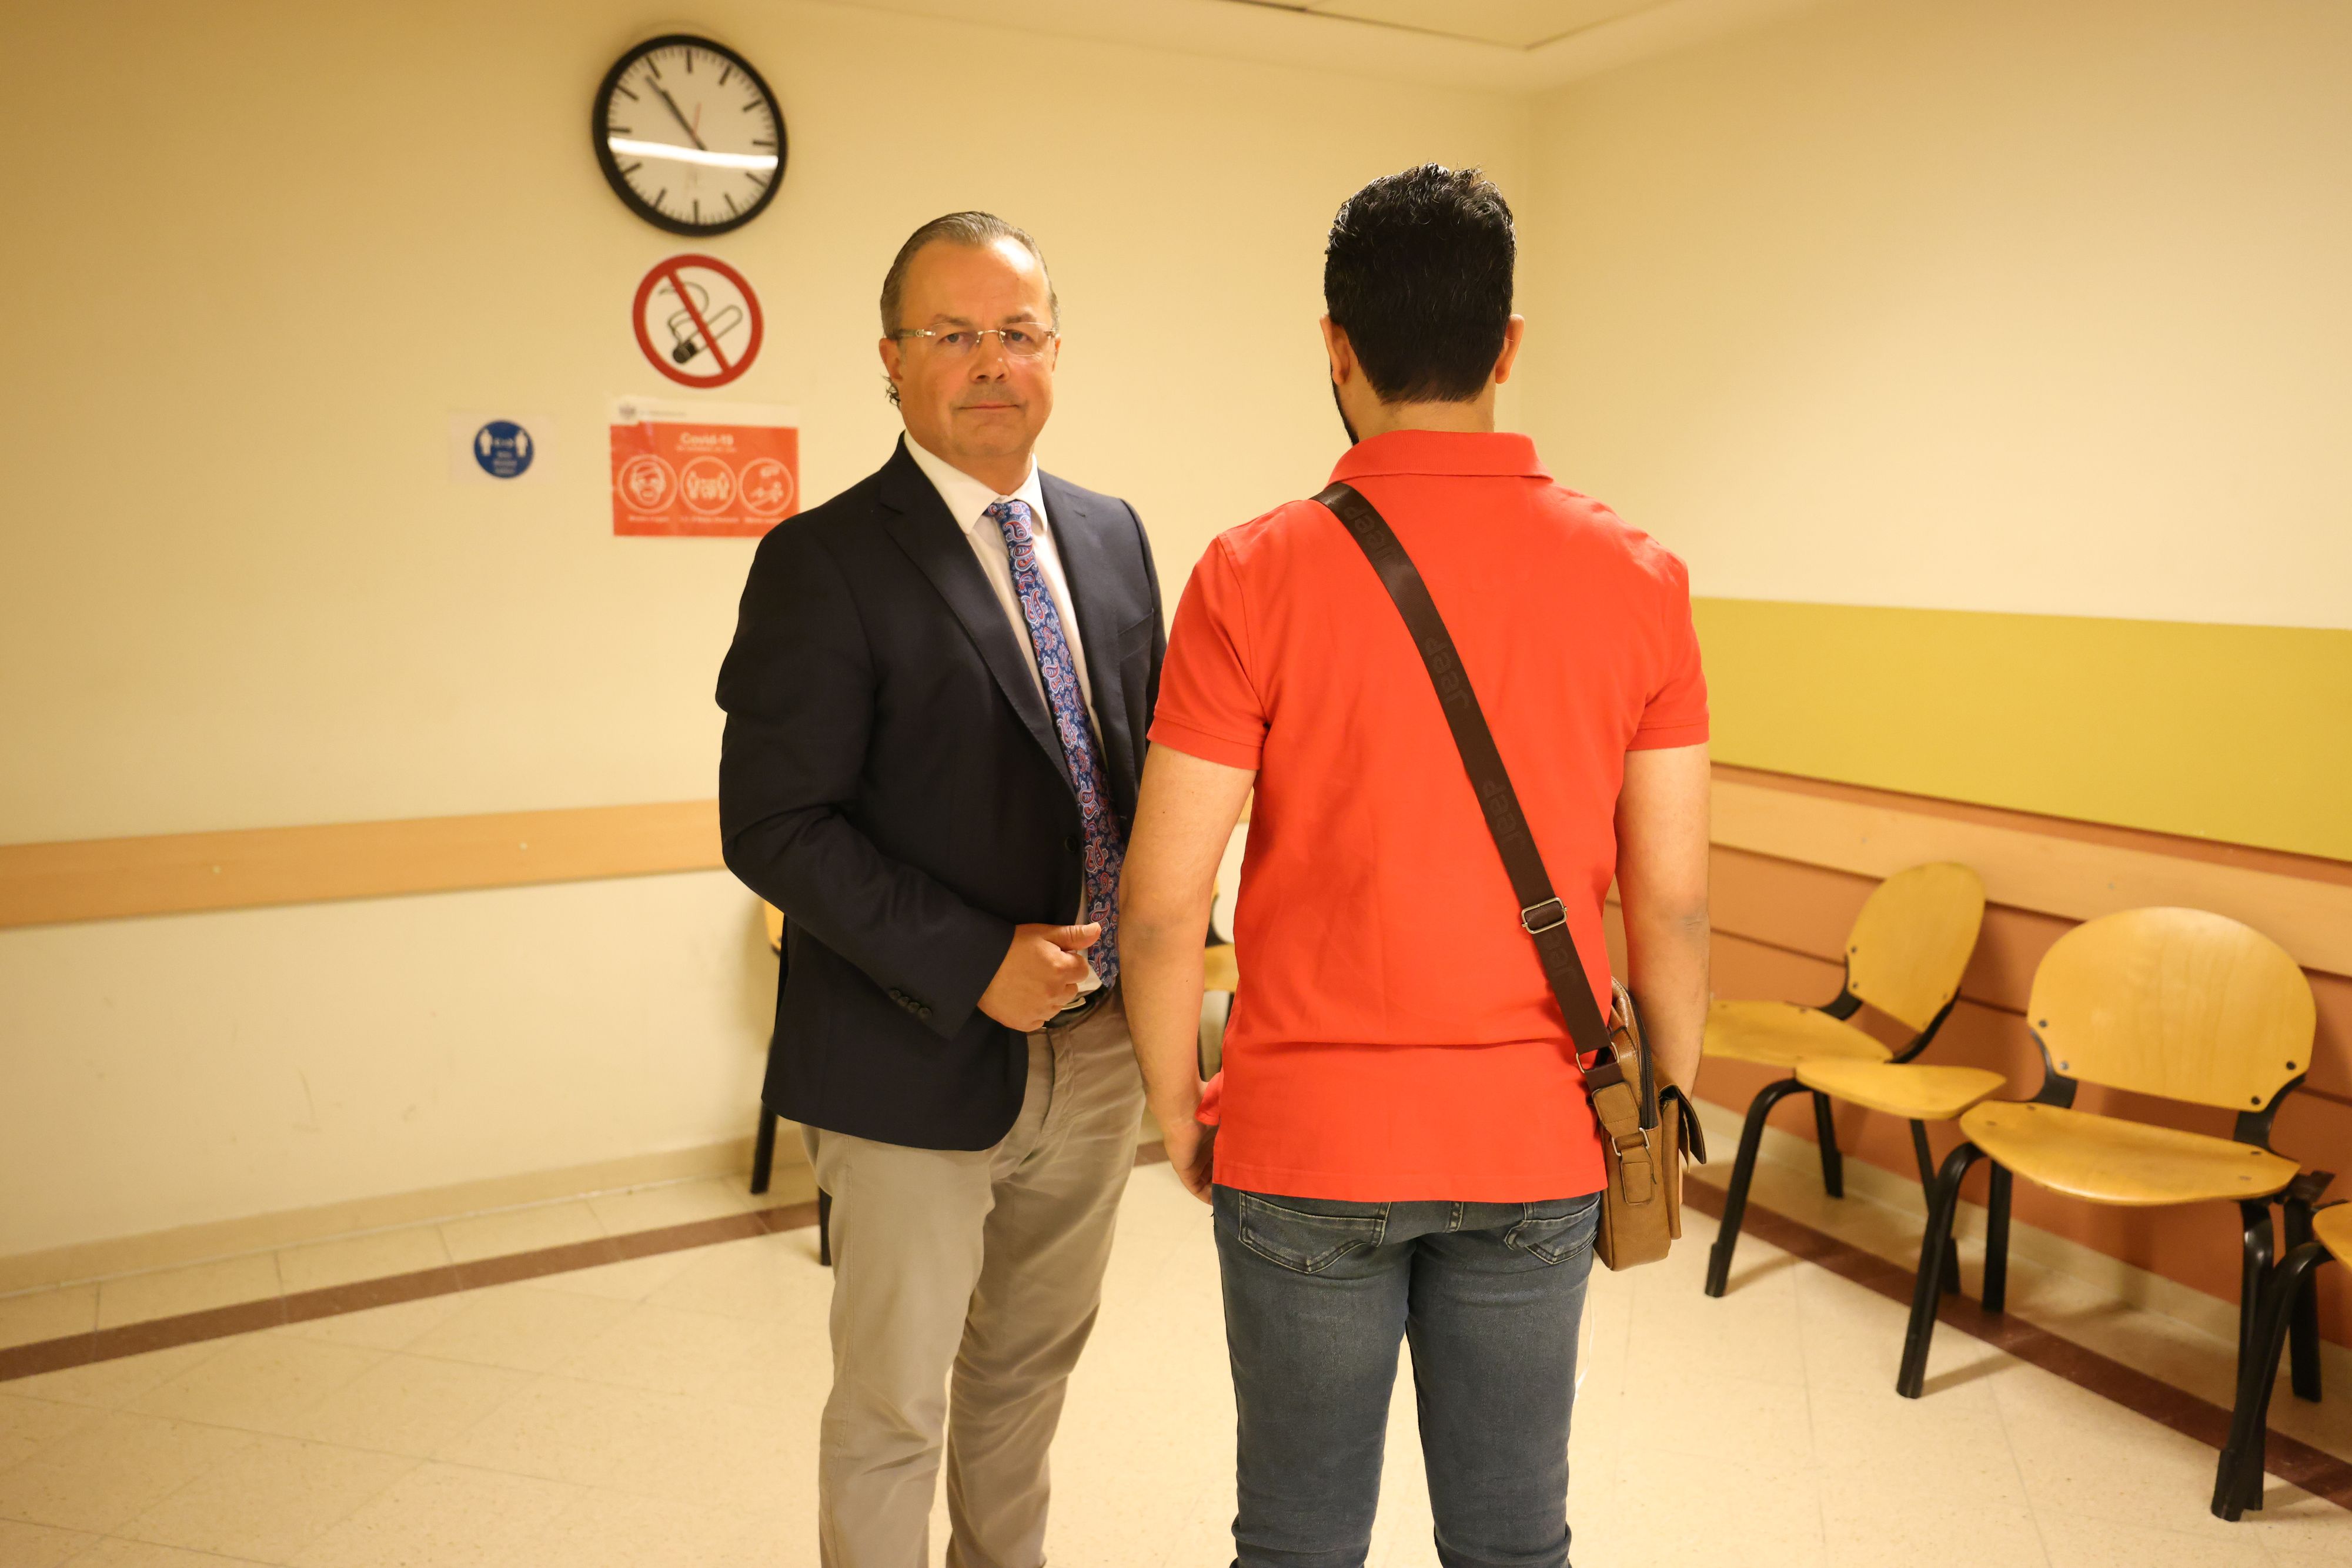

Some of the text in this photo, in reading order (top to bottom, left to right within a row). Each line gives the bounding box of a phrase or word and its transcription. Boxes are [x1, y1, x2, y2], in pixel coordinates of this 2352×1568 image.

[1424, 637, 1469, 708] Jeep
[1481, 779, 1526, 851] Jeep
[1541, 929, 1578, 984] Jee
